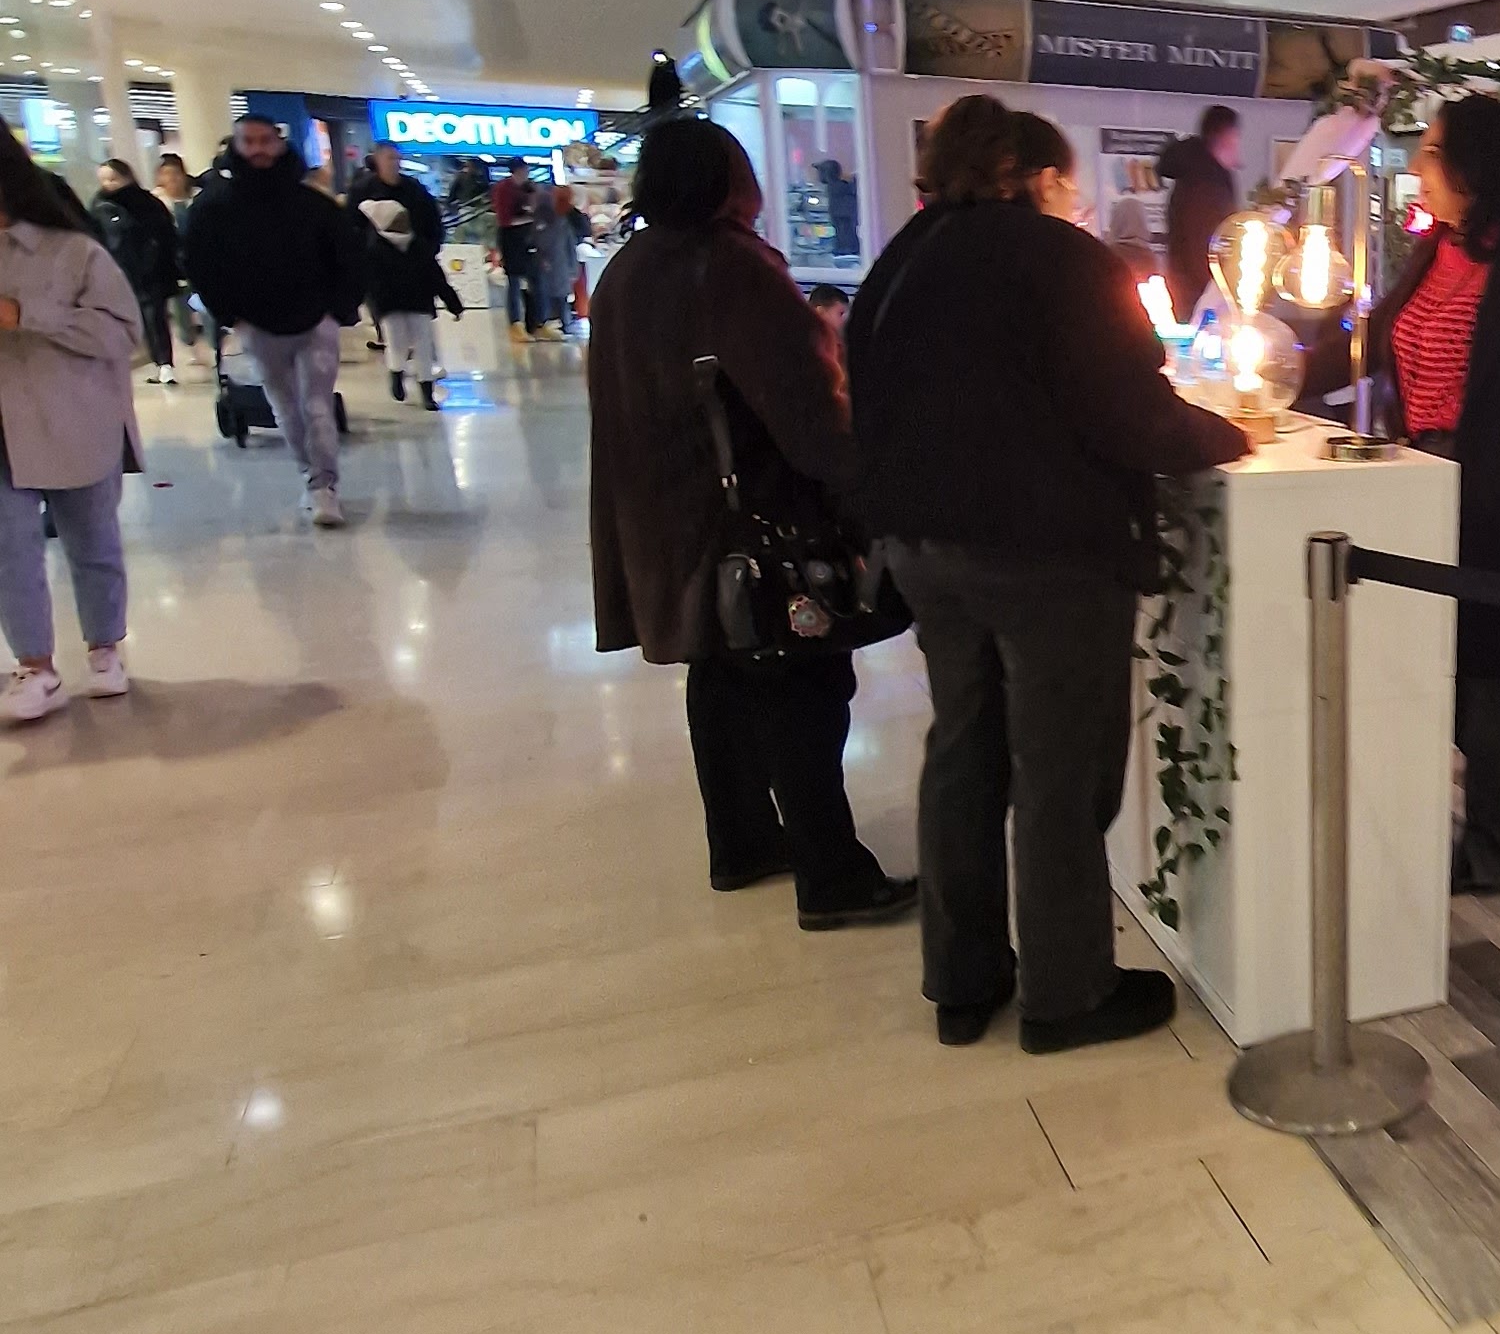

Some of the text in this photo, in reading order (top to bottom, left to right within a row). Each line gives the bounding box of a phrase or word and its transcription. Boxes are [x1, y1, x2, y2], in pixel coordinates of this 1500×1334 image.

[1037, 33, 1260, 71] MISTER MINIT
[385, 111, 586, 148] DECATHLON
